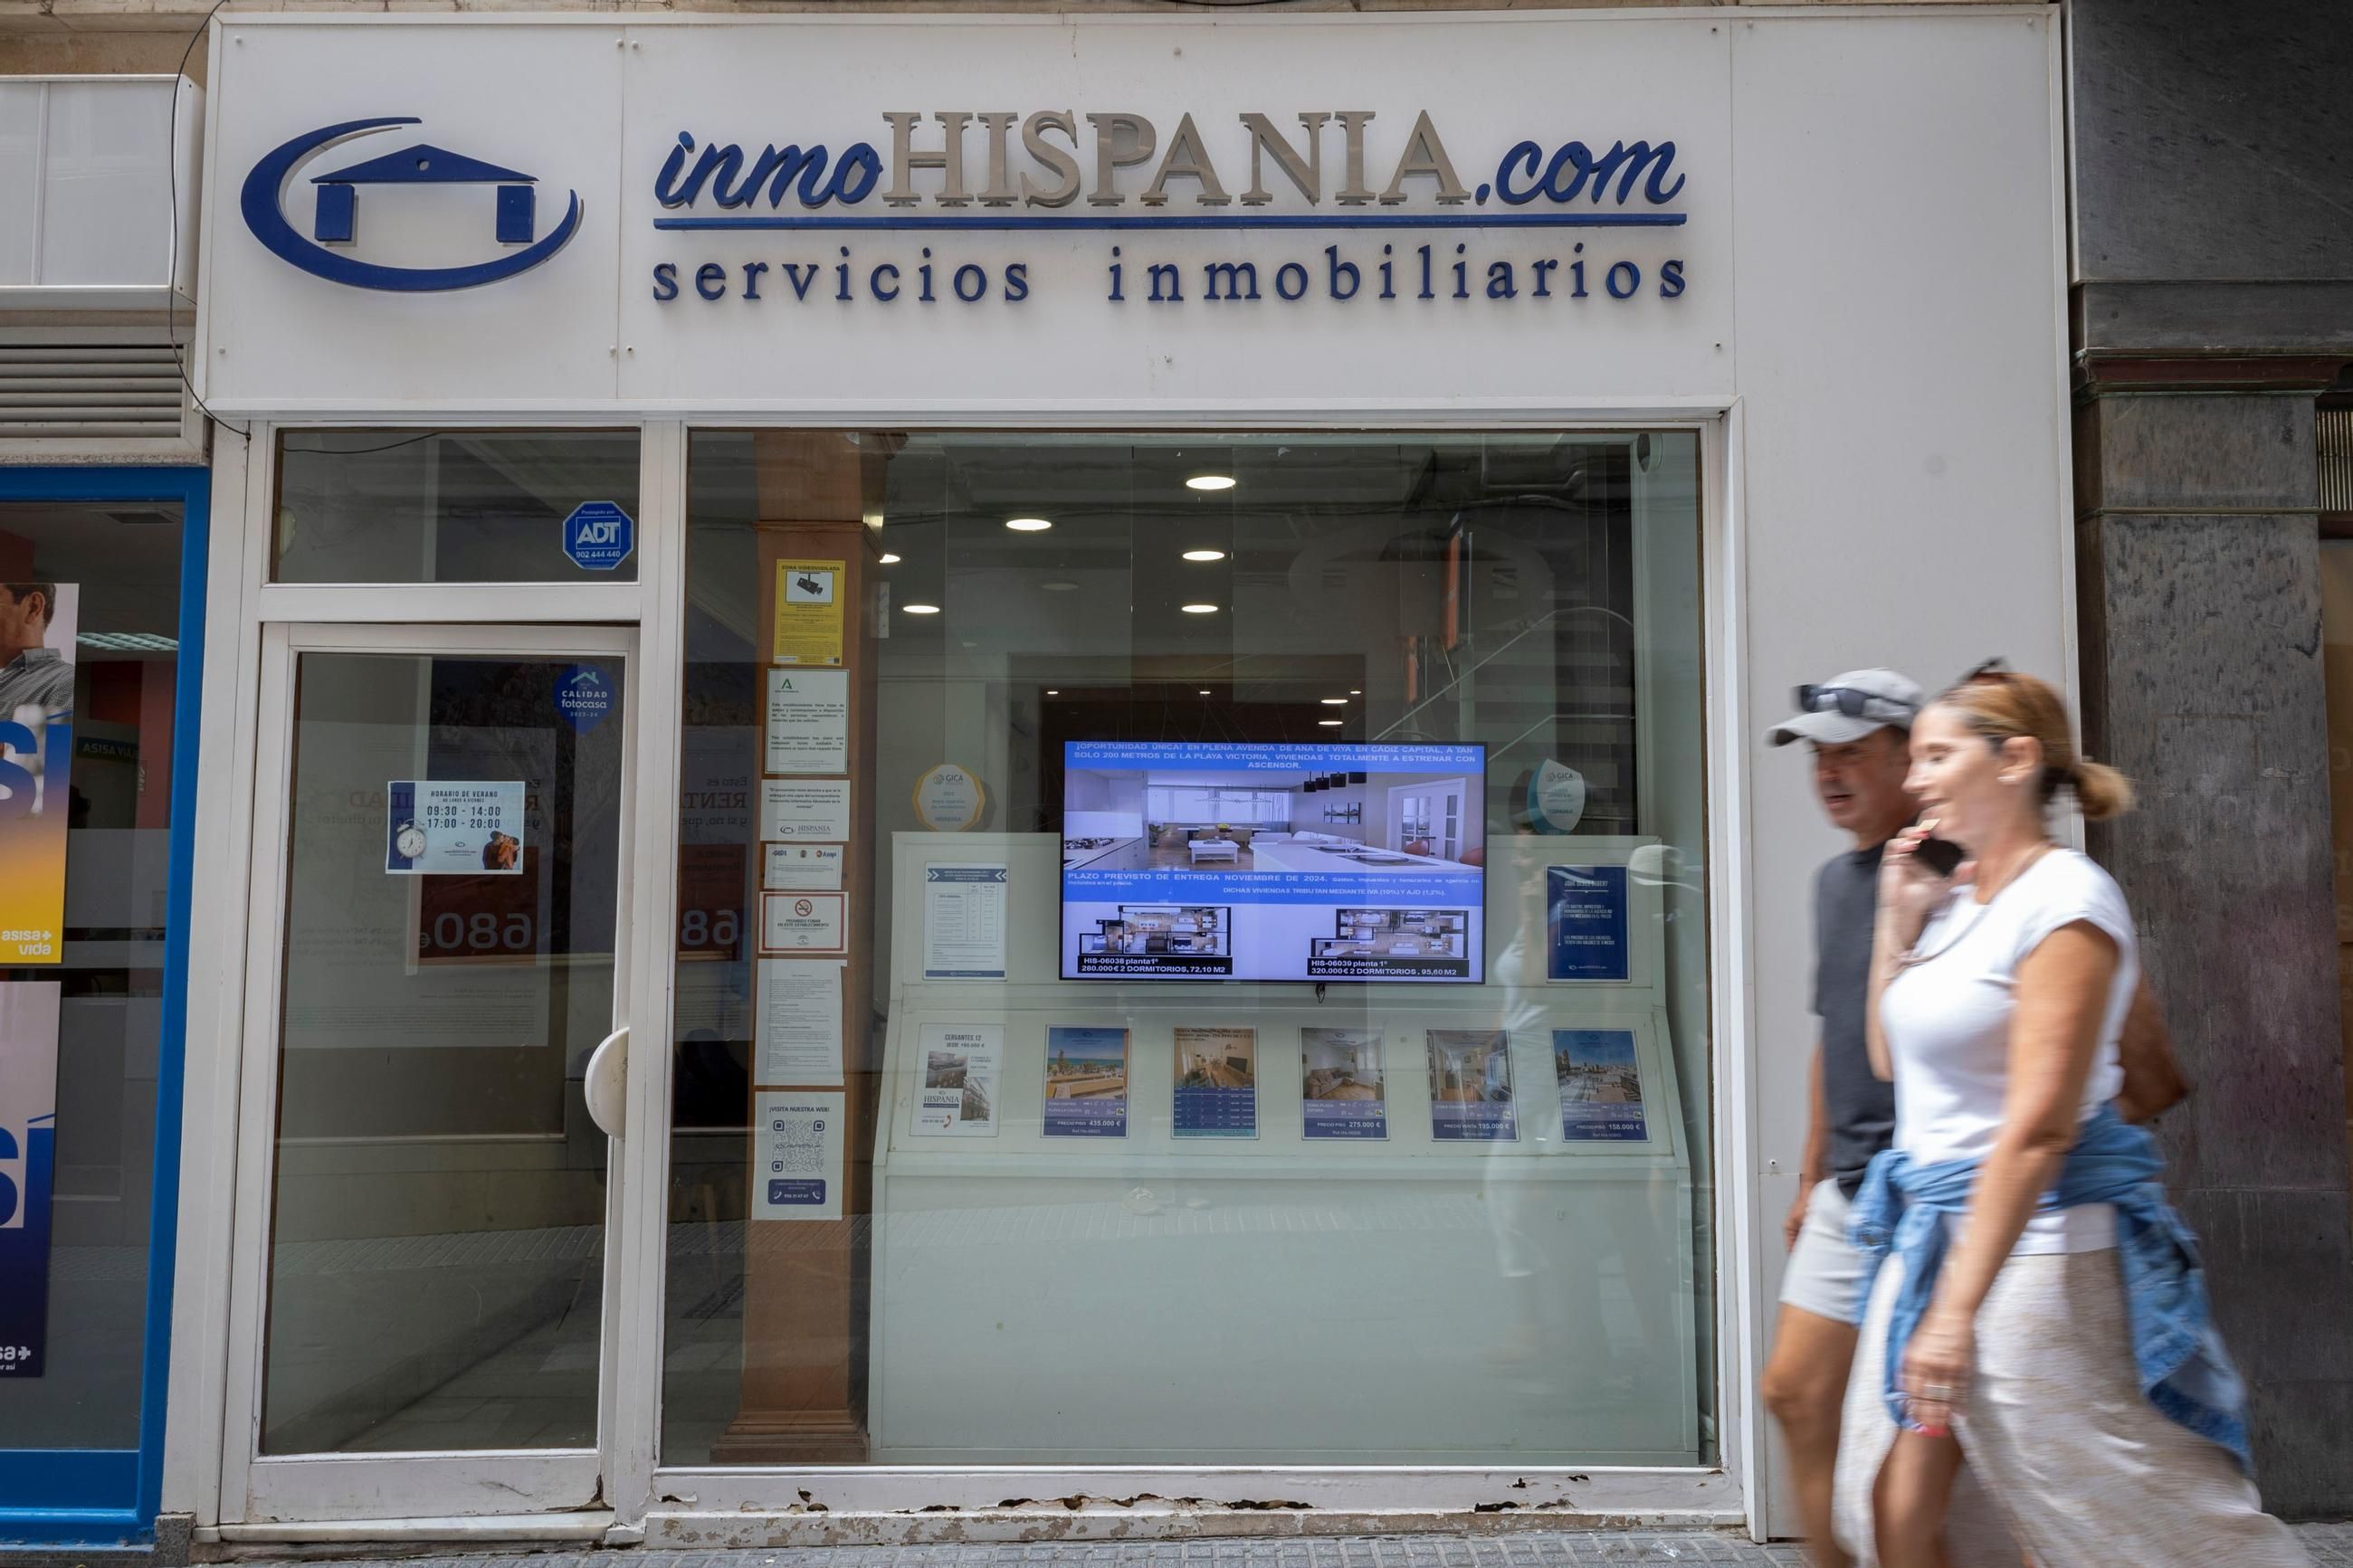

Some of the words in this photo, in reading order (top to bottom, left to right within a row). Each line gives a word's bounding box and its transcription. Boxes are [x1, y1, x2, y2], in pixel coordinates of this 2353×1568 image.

[653, 245, 1030, 301] servicios
[1107, 242, 1686, 301] inmobiliarios
[577, 521, 620, 544] ADT
[561, 690, 608, 698] CALIDAD
[561, 698, 607, 708] fotocasa
[82, 743, 116, 755] ASISA
[1076, 743, 1148, 752] ¡OPORTUNIDAD
[1203, 744, 1233, 752] PLENA
[1371, 745, 1398, 753] CÁDIZ
[1402, 755, 1453, 763] ESTRENAR
[945, 774, 964, 782] GICA
[462, 790, 470, 798] DE
[426, 805, 457, 816] 09:30
[472, 806, 500, 816] 14:00
[428, 818, 457, 828] 17:00
[470, 818, 500, 829] 20:00
[1174, 873, 1220, 881] ENTREGA
[18, 943, 52, 955] vida
[924, 1095, 959, 1103] HISPANIA
